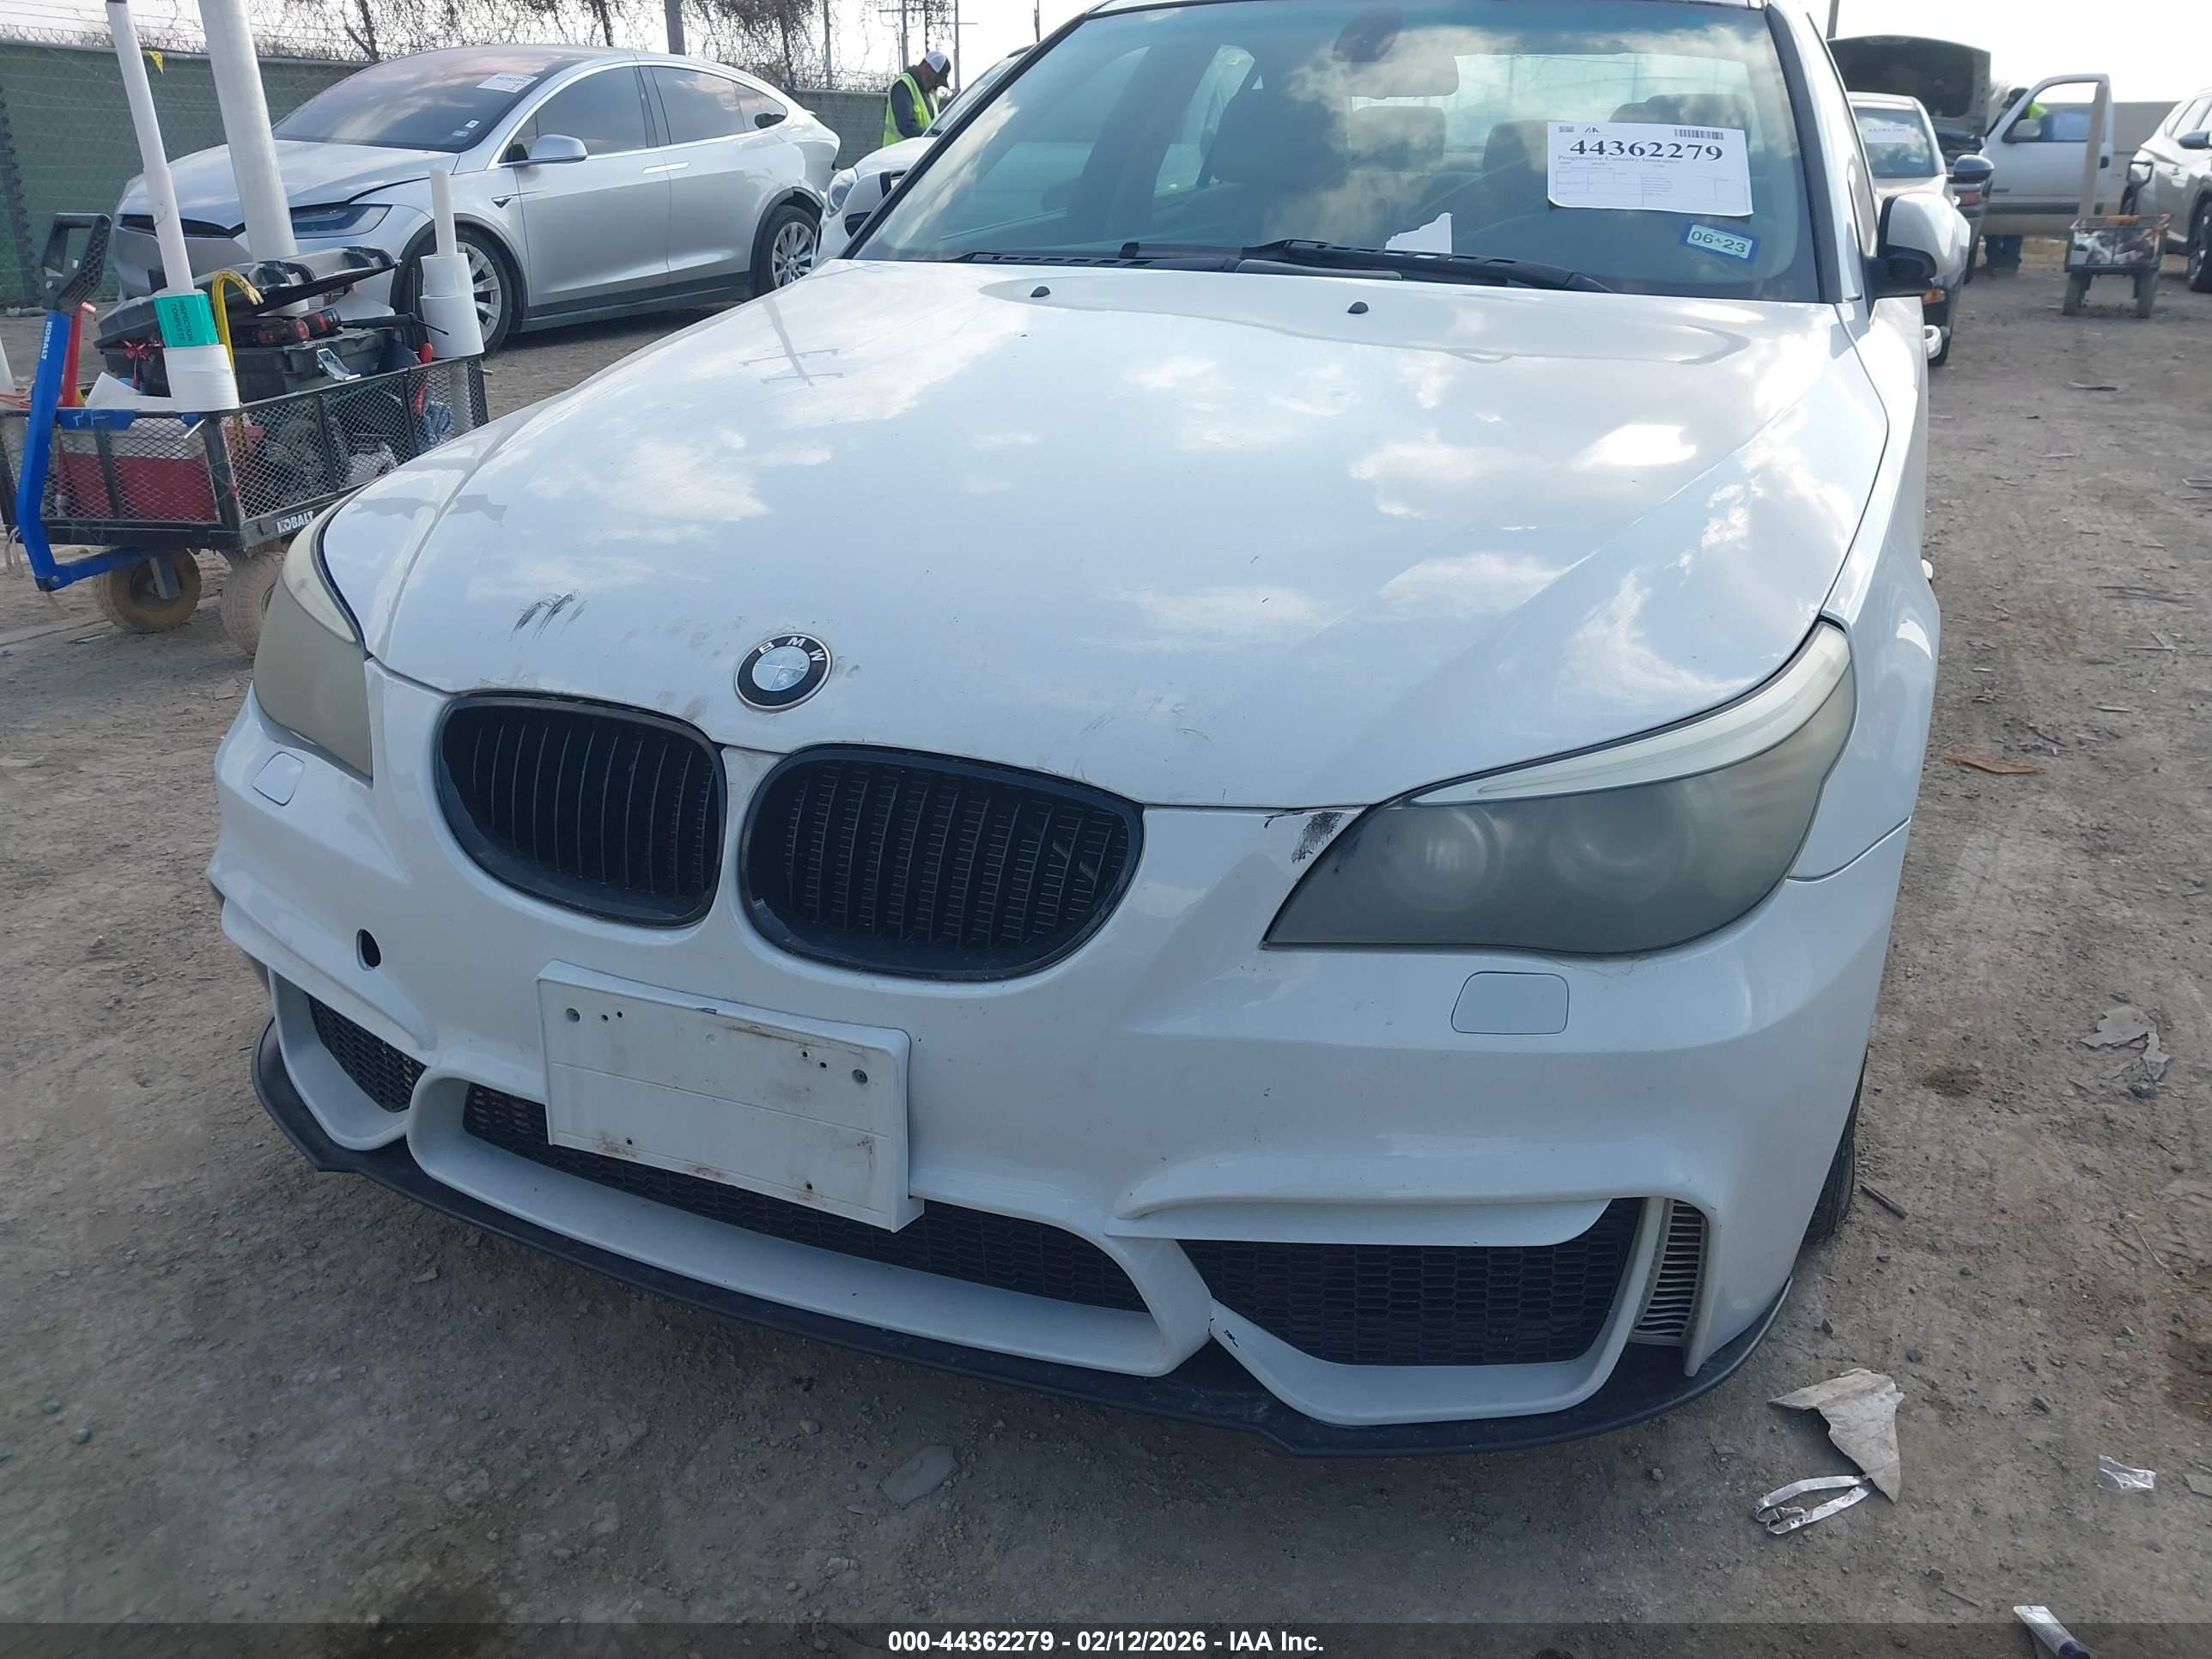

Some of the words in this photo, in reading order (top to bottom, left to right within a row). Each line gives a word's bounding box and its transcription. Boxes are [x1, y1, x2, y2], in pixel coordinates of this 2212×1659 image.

[1570, 139, 1723, 161] 44362279
[171, 303, 185, 341] COMPLETE
[178, 299, 194, 342] INSPECTION
[41, 321, 53, 360] KOBALT
[276, 510, 314, 533] KOBALT
[758, 636, 826, 662] BMW
